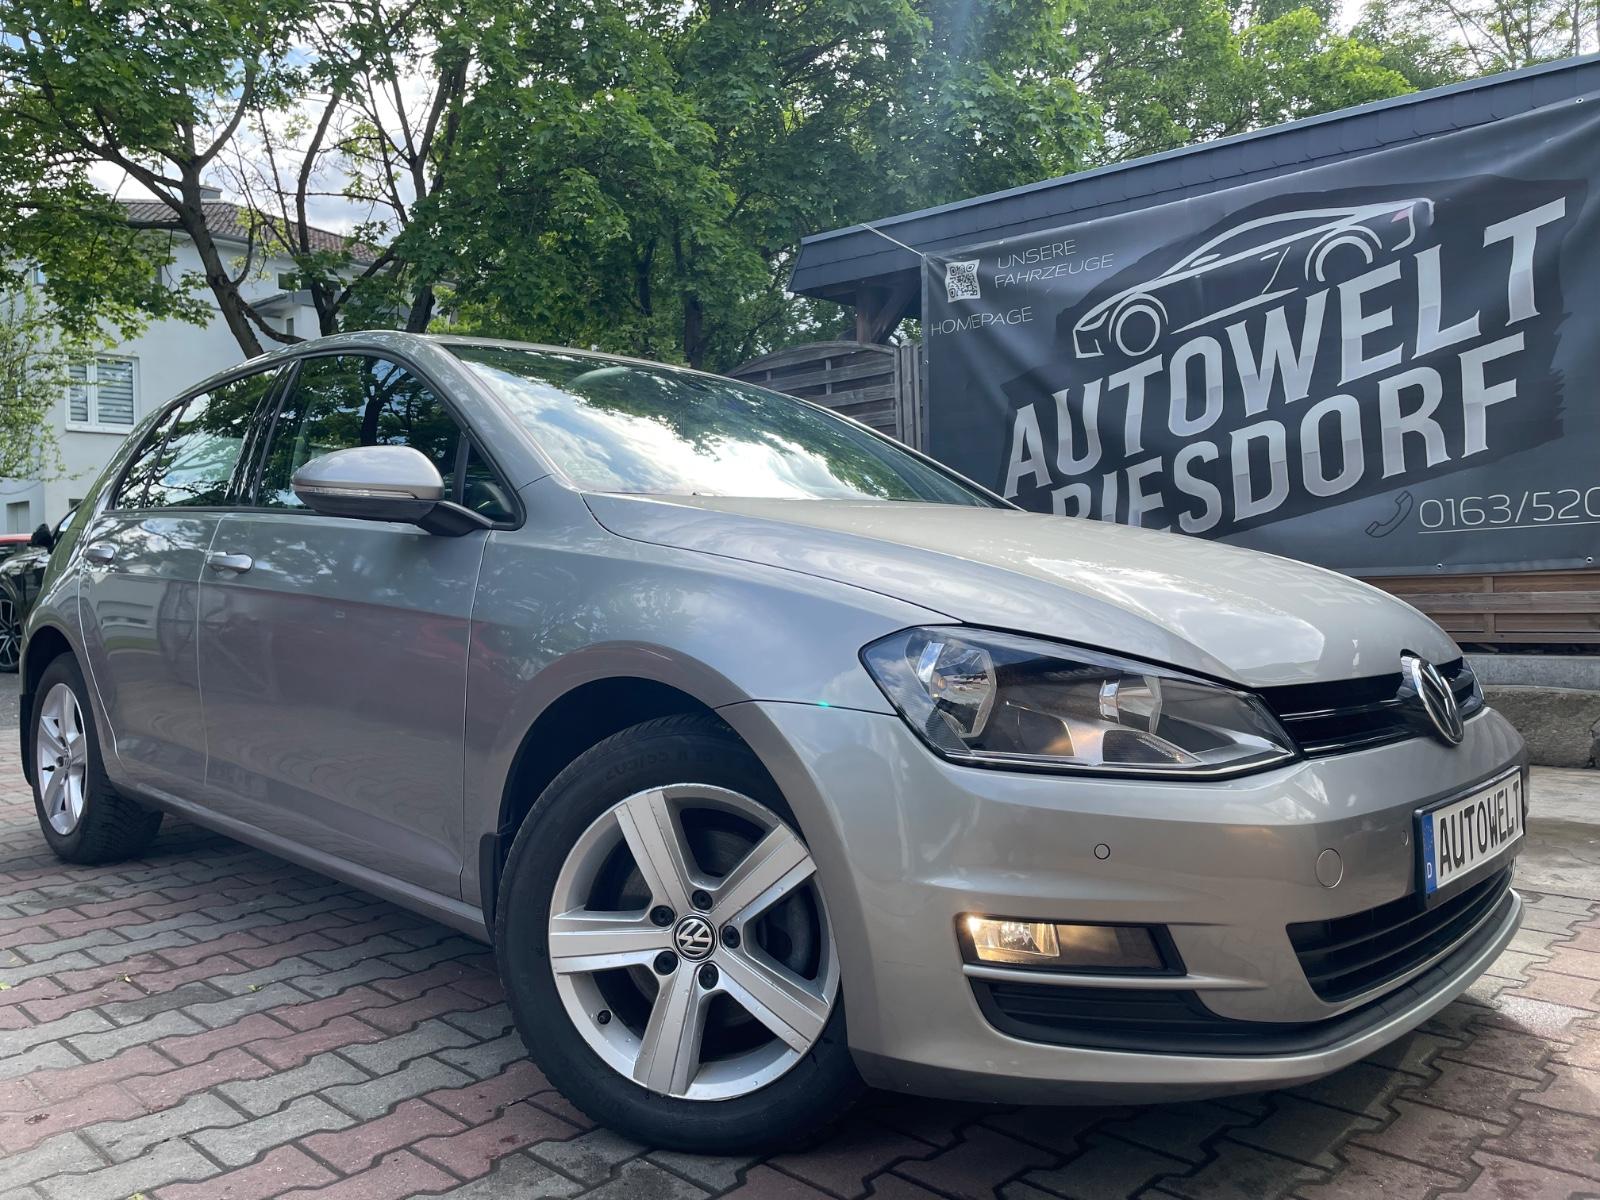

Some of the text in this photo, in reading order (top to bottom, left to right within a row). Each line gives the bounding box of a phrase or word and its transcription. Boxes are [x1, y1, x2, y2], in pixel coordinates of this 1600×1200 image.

[994, 253, 1115, 289] FAHRZEUGE
[997, 239, 1077, 269] UNSERE
[930, 306, 1034, 337] HOMEPAGE
[1003, 196, 1567, 499] AUTOWELT
[1418, 486, 1600, 528] 0163/520
[1439, 780, 1519, 877] AUTOWELT
